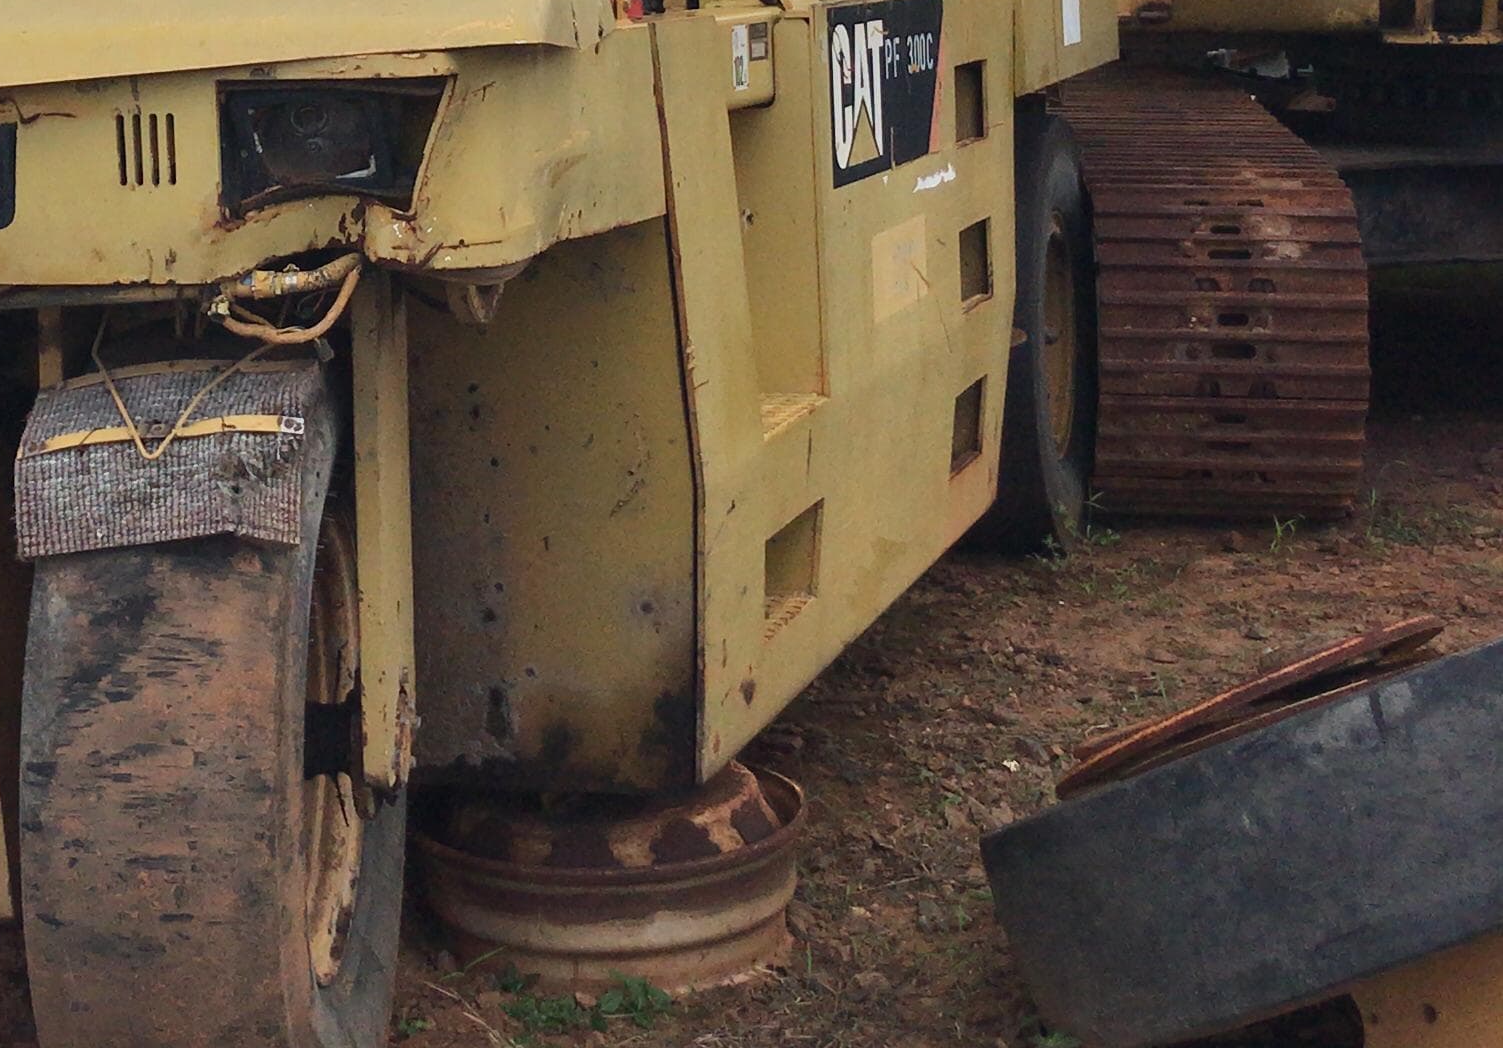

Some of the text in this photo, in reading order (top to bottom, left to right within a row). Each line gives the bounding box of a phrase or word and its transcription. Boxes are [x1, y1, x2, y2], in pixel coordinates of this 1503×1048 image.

[832, 19, 934, 170] CAT PF 300C
